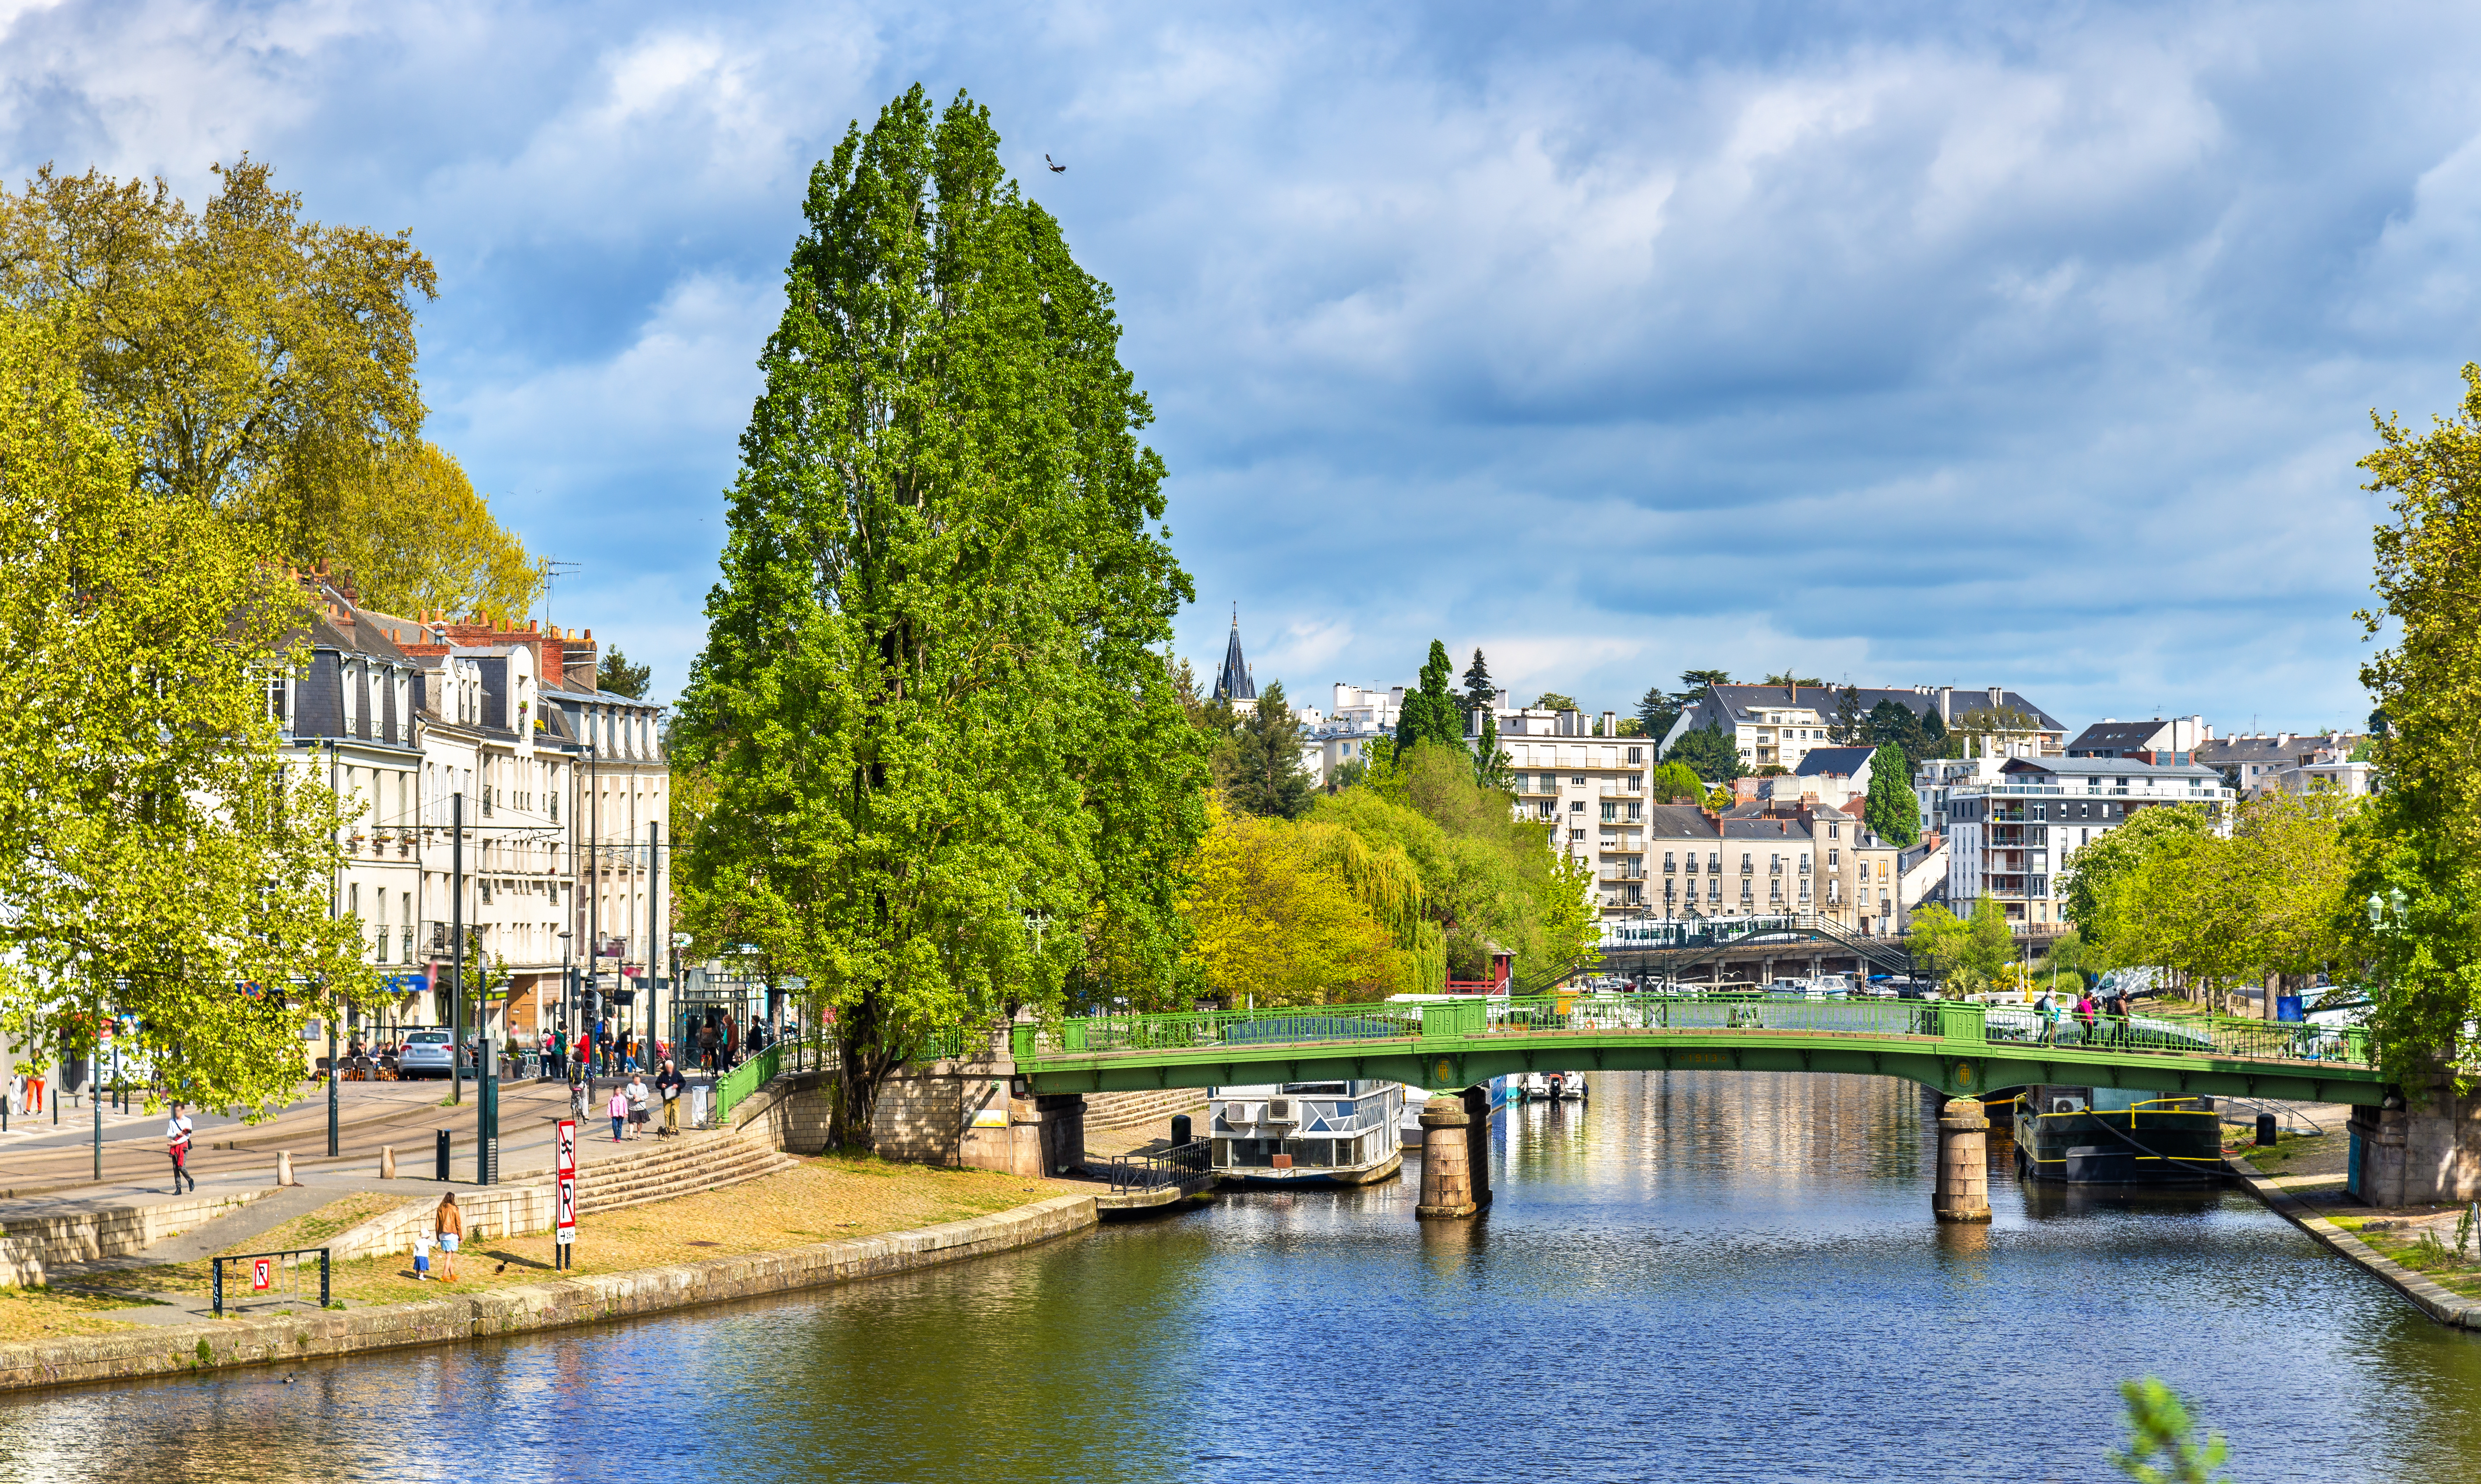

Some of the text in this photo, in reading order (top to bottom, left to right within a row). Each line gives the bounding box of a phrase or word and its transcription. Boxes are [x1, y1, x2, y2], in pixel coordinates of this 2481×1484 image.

[1689, 1054, 1717, 1062] 1913
[563, 1183, 571, 1218] P
[259, 1266, 265, 1283] P
